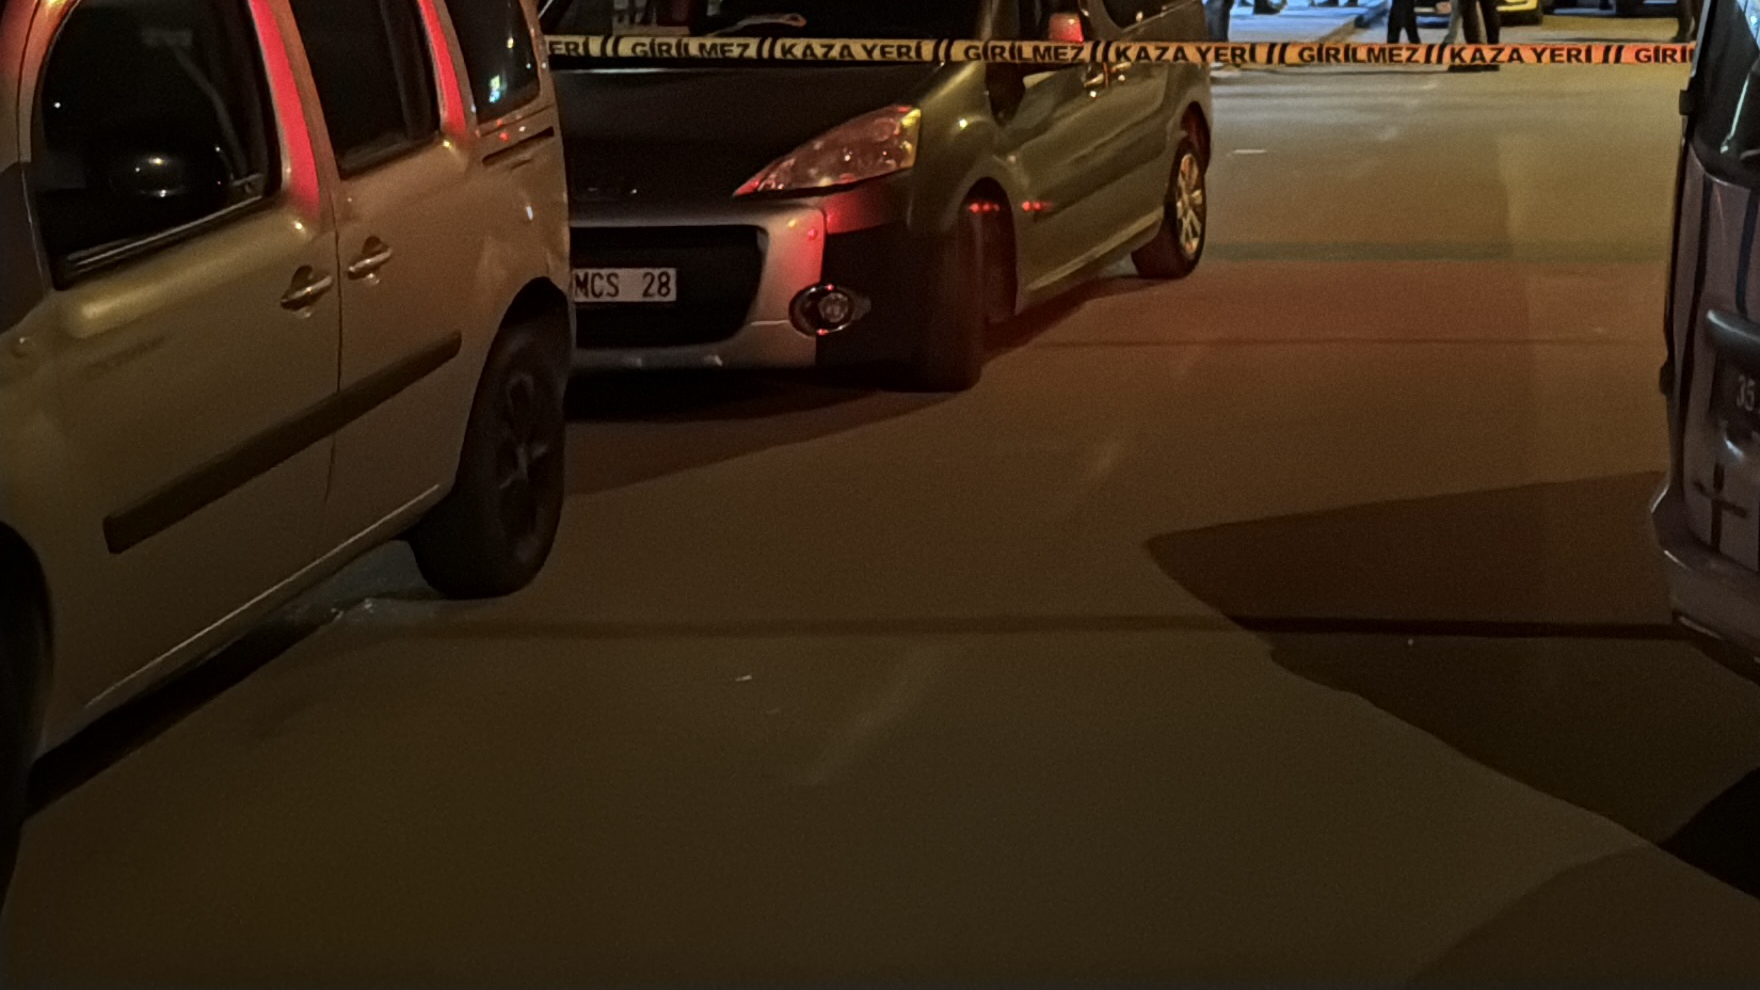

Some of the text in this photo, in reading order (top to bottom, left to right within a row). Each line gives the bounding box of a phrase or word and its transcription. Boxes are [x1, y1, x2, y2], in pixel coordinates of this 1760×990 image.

[548, 37, 590, 57] ERİ
[780, 43, 855, 60] KAZA
[1115, 46, 1188, 62] KAZA
[1450, 47, 1525, 64] KAZA
[574, 271, 671, 298] MCS 28
